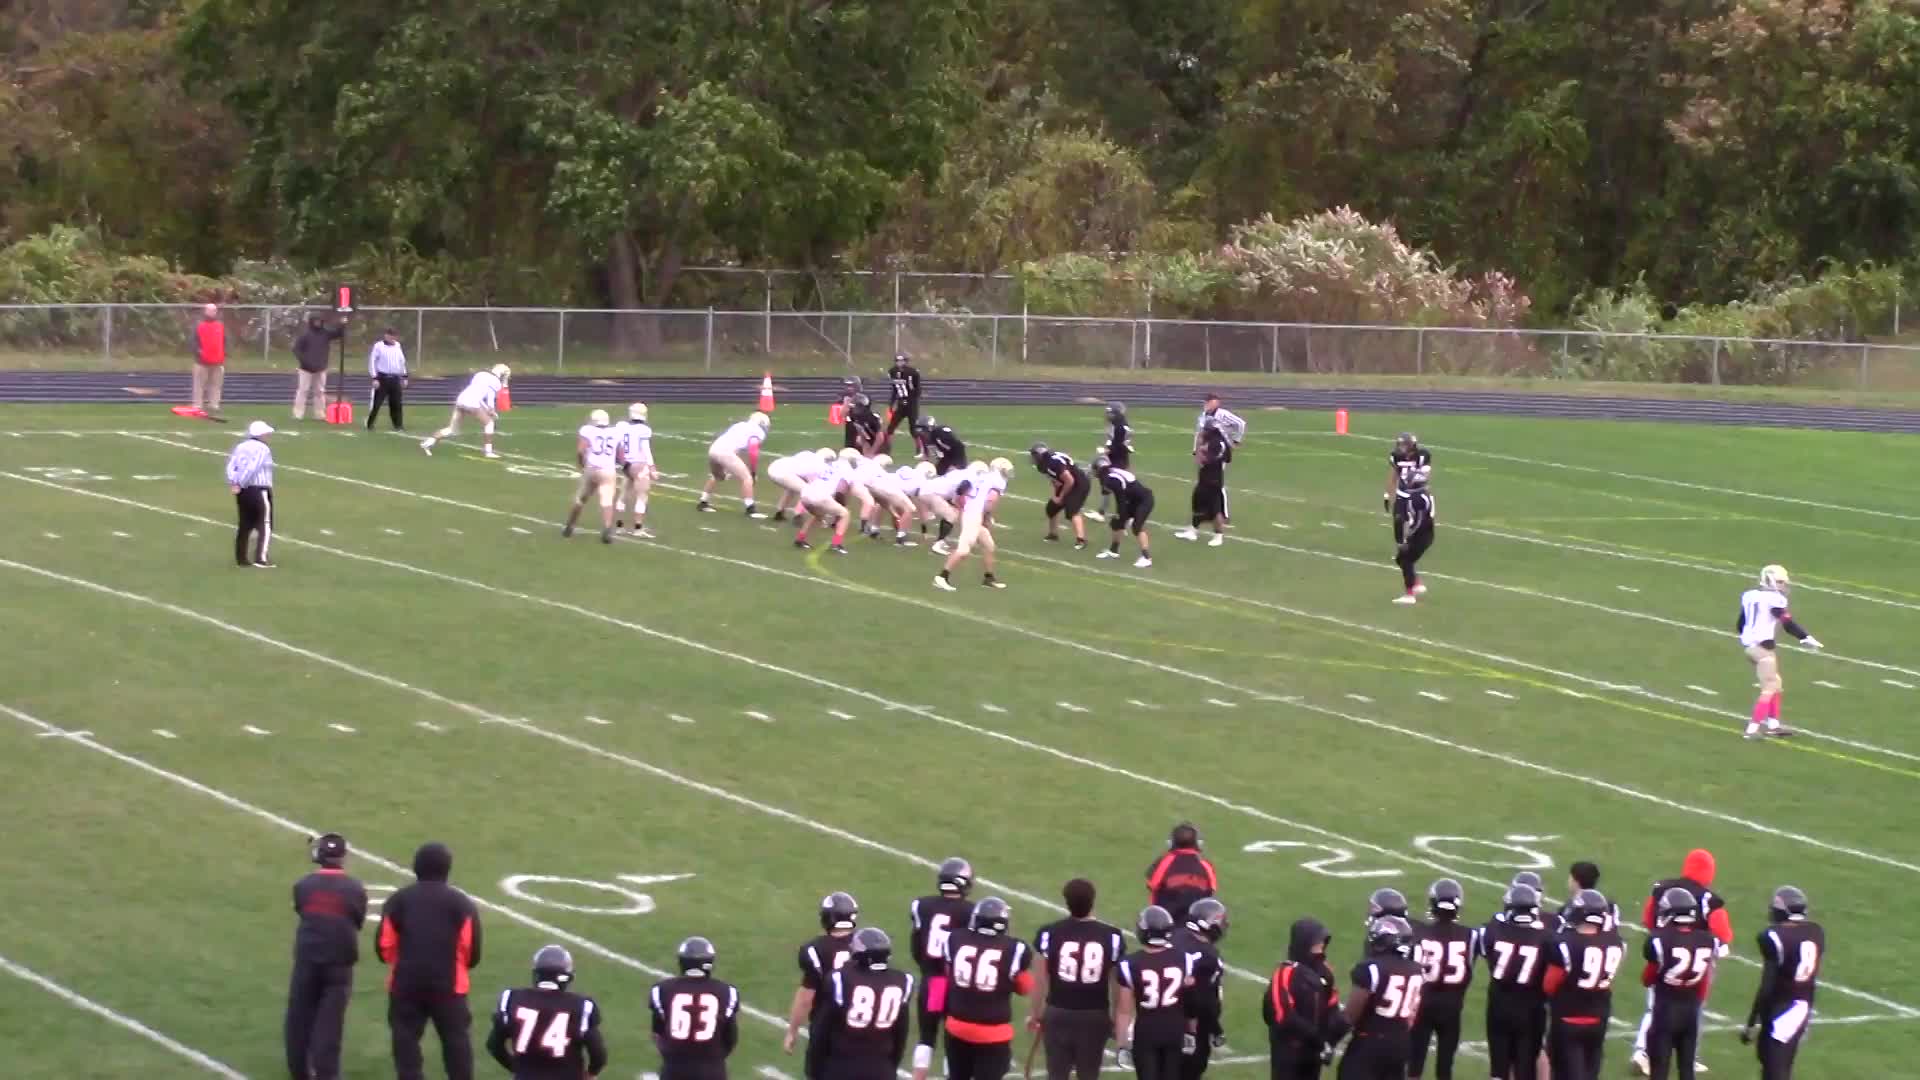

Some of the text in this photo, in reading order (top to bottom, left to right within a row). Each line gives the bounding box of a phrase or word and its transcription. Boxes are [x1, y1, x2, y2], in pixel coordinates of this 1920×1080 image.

[953, 944, 1003, 991] 66
[1057, 940, 1105, 984] 68
[1492, 940, 1539, 984] 77
[1576, 945, 1623, 989] 99
[1662, 946, 1713, 987] 25
[1793, 940, 1817, 982] 8
[846, 985, 905, 1029] 80
[1139, 966, 1184, 1010] 32
[1374, 974, 1423, 1019] 50
[513, 1006, 572, 1059] 74
[669, 991, 721, 1042] 63
